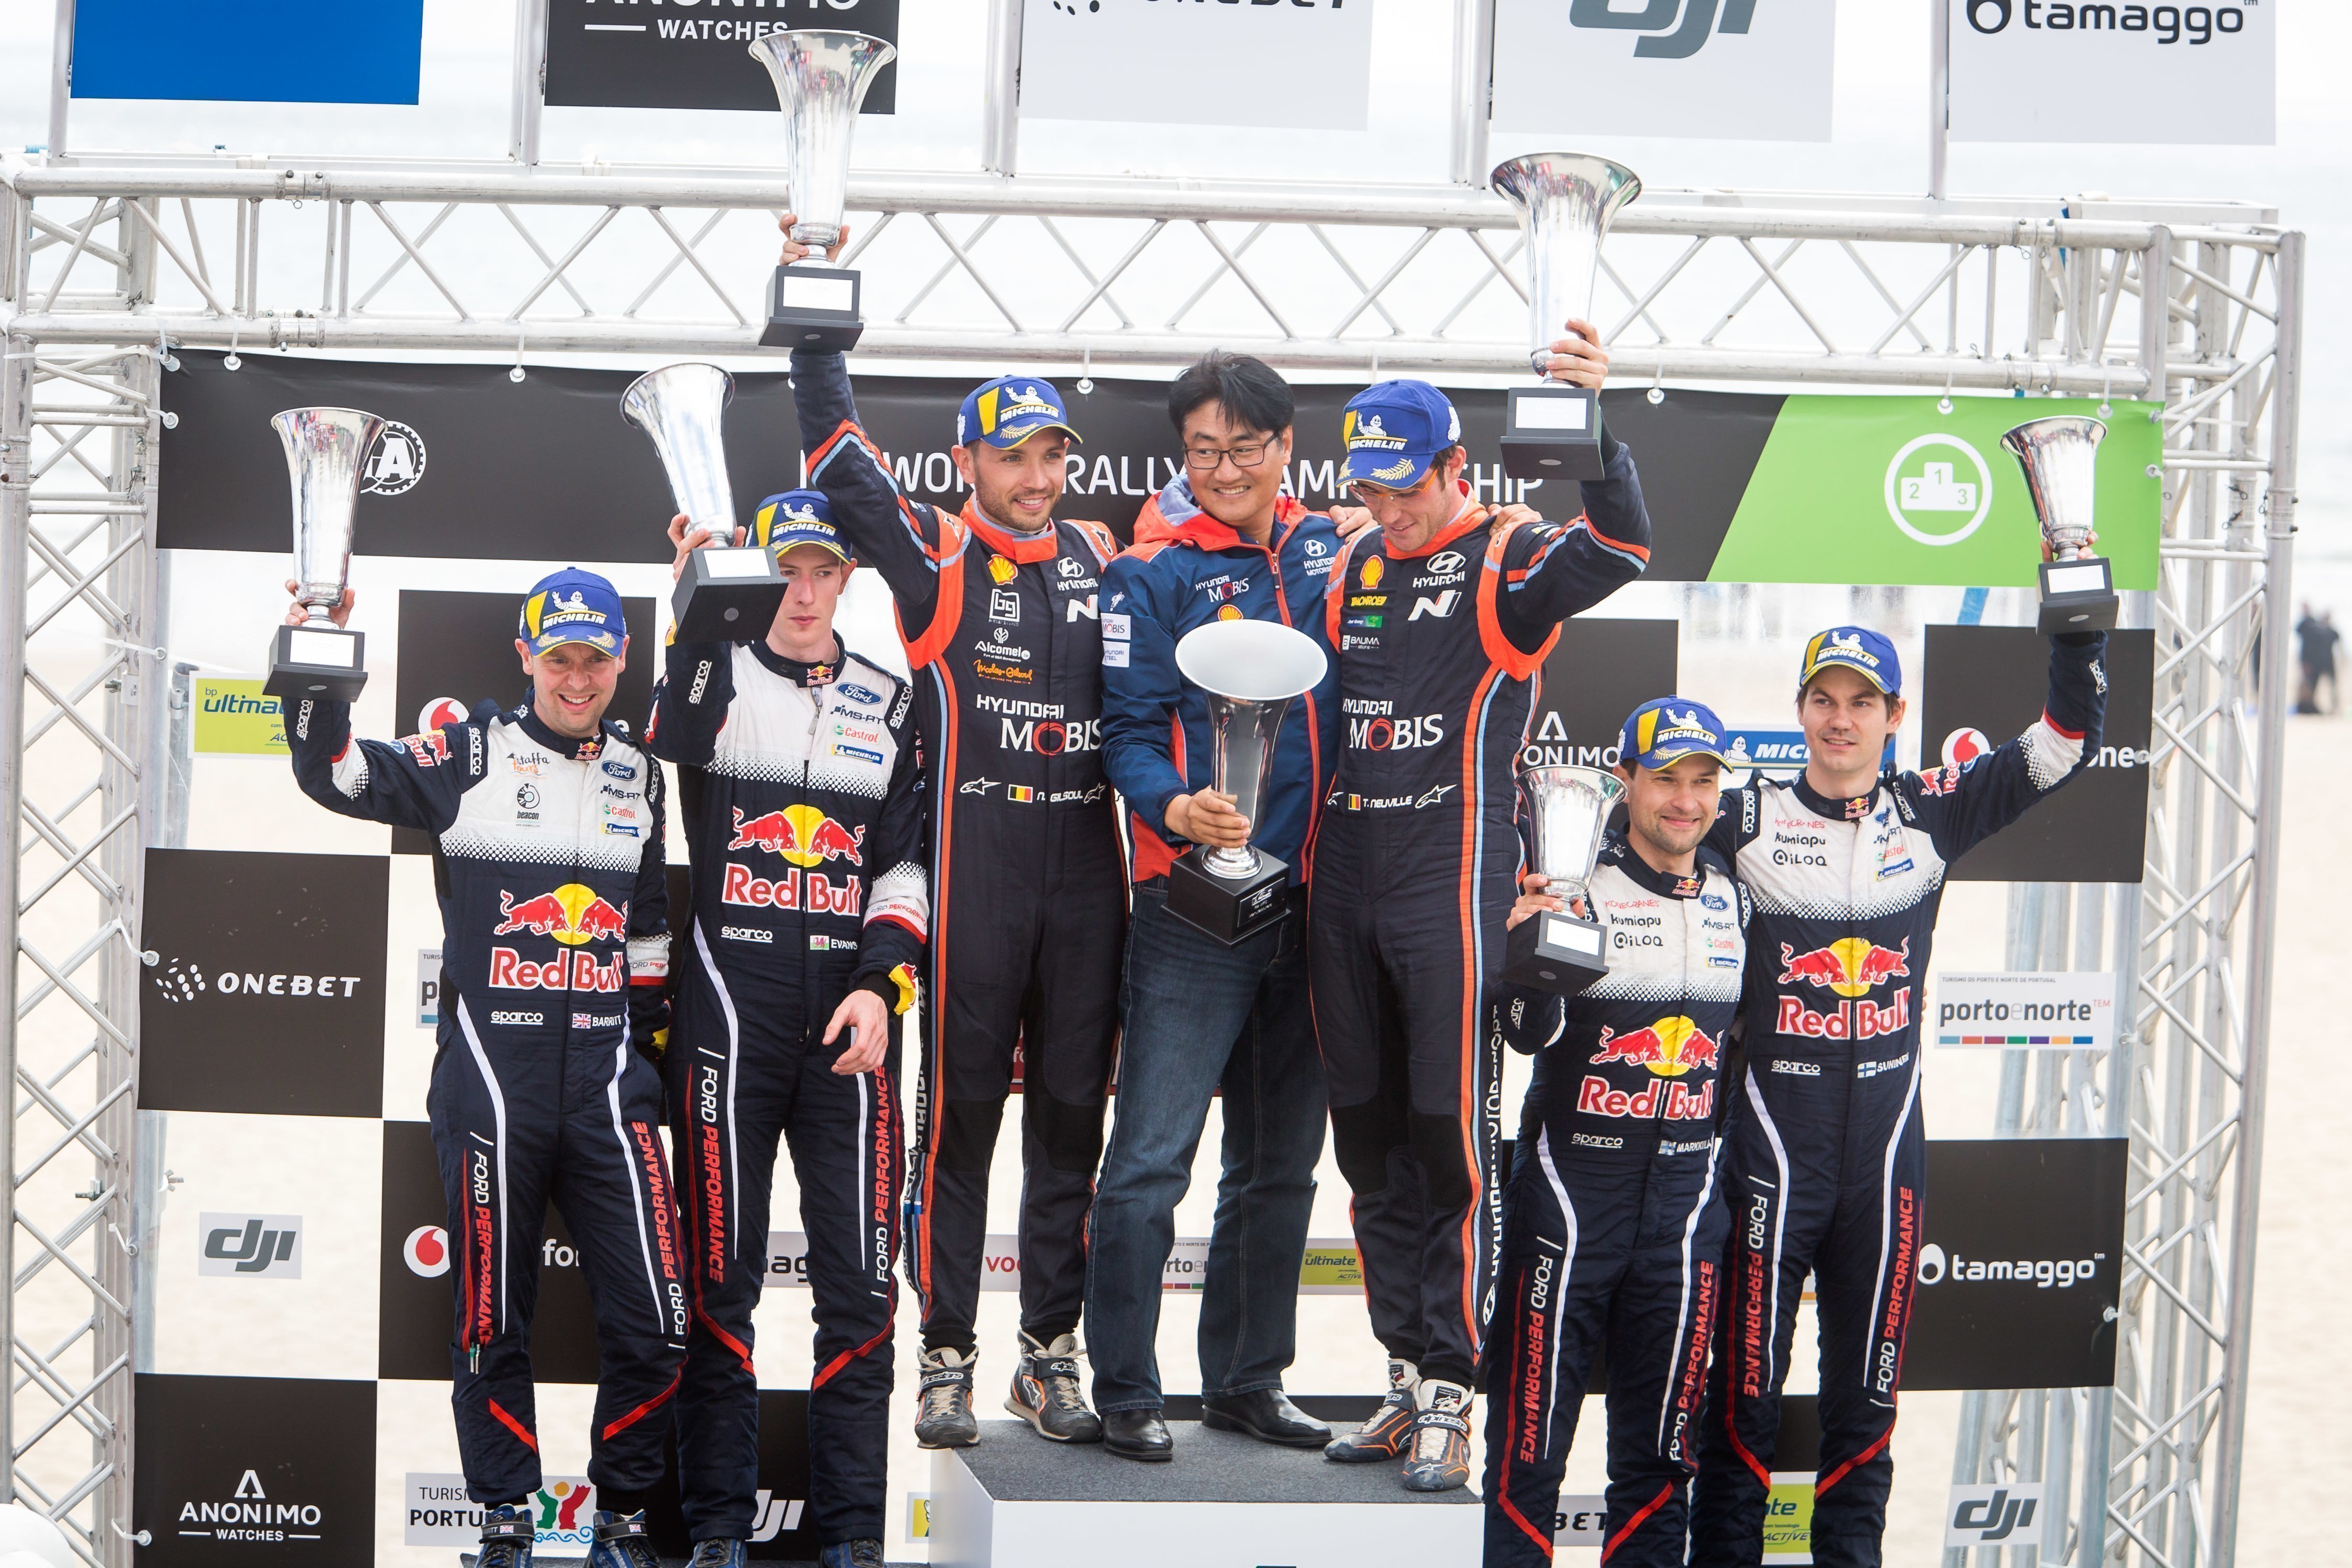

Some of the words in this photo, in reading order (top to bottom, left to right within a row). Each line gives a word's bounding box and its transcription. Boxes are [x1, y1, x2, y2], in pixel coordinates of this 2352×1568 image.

[658, 19, 788, 41] WATCHES
[2023, 0, 2244, 45] tamaggo
[1000, 406, 1059, 423] MICHELIN
[1934, 468, 1941, 484] 1
[1909, 483, 1920, 499] 2
[1958, 489, 1968, 504] 3
[773, 523, 836, 538] MICHELIN
[1304, 557, 1335, 570] HYUND
[1307, 566, 1332, 576] MOTORS
[1057, 578, 1098, 591] HYUNDAI
[1195, 575, 1230, 591] HYUNDAI
[1413, 571, 1466, 588] HYUNDAI
[1207, 578, 1250, 603] MOBIS
[543, 613, 606, 630] MICHELIN
[1351, 637, 1380, 645] BAUMA
[1817, 648, 1878, 668] MICHELIN
[688, 660, 711, 704] sparco
[205, 687, 217, 697] bp
[845, 685, 873, 704] Ford
[890, 686, 913, 729] sparco
[976, 694, 1065, 719] HYUNDAI
[1343, 698, 1393, 716] HYUNDAI
[296, 699, 313, 740] sparco
[840, 708, 884, 725] MS-RT
[845, 727, 879, 743] Castrol
[1000, 718, 1101, 756] MOBIS
[1348, 713, 1444, 751] MOBIS
[1656, 731, 1717, 746] MICHELIN
[469, 727, 482, 776] sparco
[846, 749, 880, 762] MICHELIN
[1523, 745, 1621, 767] ONIMO
[607, 764, 632, 778] Ford
[1050, 790, 1083, 802] GILSOUL
[1363, 798, 1369, 807] T.
[1370, 795, 1413, 809] NEUVILLE
[517, 811, 539, 820] beacon
[612, 805, 636, 820] Castrol
[1742, 789, 1755, 834] sparco
[1775, 832, 1826, 848] kumiapu
[721, 862, 800, 910] Red
[806, 873, 862, 917] Bull
[1611, 914, 1661, 928] kumiapu
[721, 926, 773, 943] sparco
[1714, 938, 1735, 950] Castrol
[831, 939, 858, 950] EVANS
[489, 947, 570, 990] Red
[571, 950, 624, 993] Bull
[217, 972, 361, 998] ONEBET
[2092, 999, 2111, 1007] TEM
[490, 1010, 544, 1025] sparco
[592, 1014, 621, 1027] BARRITT
[1510, 998, 1524, 1030] arco
[1775, 995, 1851, 1040] Red
[1857, 986, 1911, 1040] Bull
[1771, 1059, 1821, 1076] sparco
[701, 1066, 718, 1123] FORD
[1577, 1075, 1663, 1119] Red
[1664, 1079, 1715, 1120] Bull
[874, 1066, 890, 1224] PERFORMANCE
[1571, 1132, 1623, 1149] sparco
[474, 1150, 489, 1204] FORD
[631, 1121, 677, 1279] PERFORMANCE
[702, 1124, 724, 1284] PERFORMANCE
[1748, 1193, 1768, 1249] FORD
[876, 1226, 889, 1283] FORD
[1305, 1255, 1356, 1266] ultimate
[1883, 1186, 1913, 1340] PERFORMANCE
[475, 1205, 494, 1344] PERFORMANCE
[1952, 1254, 2095, 1288] tamaggo
[1530, 1254, 1553, 1309] FORD
[668, 1283, 686, 1335] FORD
[1744, 1251, 1763, 1398] PERFORMANCE
[1678, 1260, 1714, 1410] PERFORMANCE
[1876, 1341, 1896, 1393] FORD
[1520, 1310, 1544, 1464] PERFORMANCE
[179, 1502, 321, 1526] ANONIMO
[410, 1508, 483, 1527] PORTU
[215, 1528, 284, 1542] WATCHES
[1764, 1532, 1810, 1541] ACTIVE
